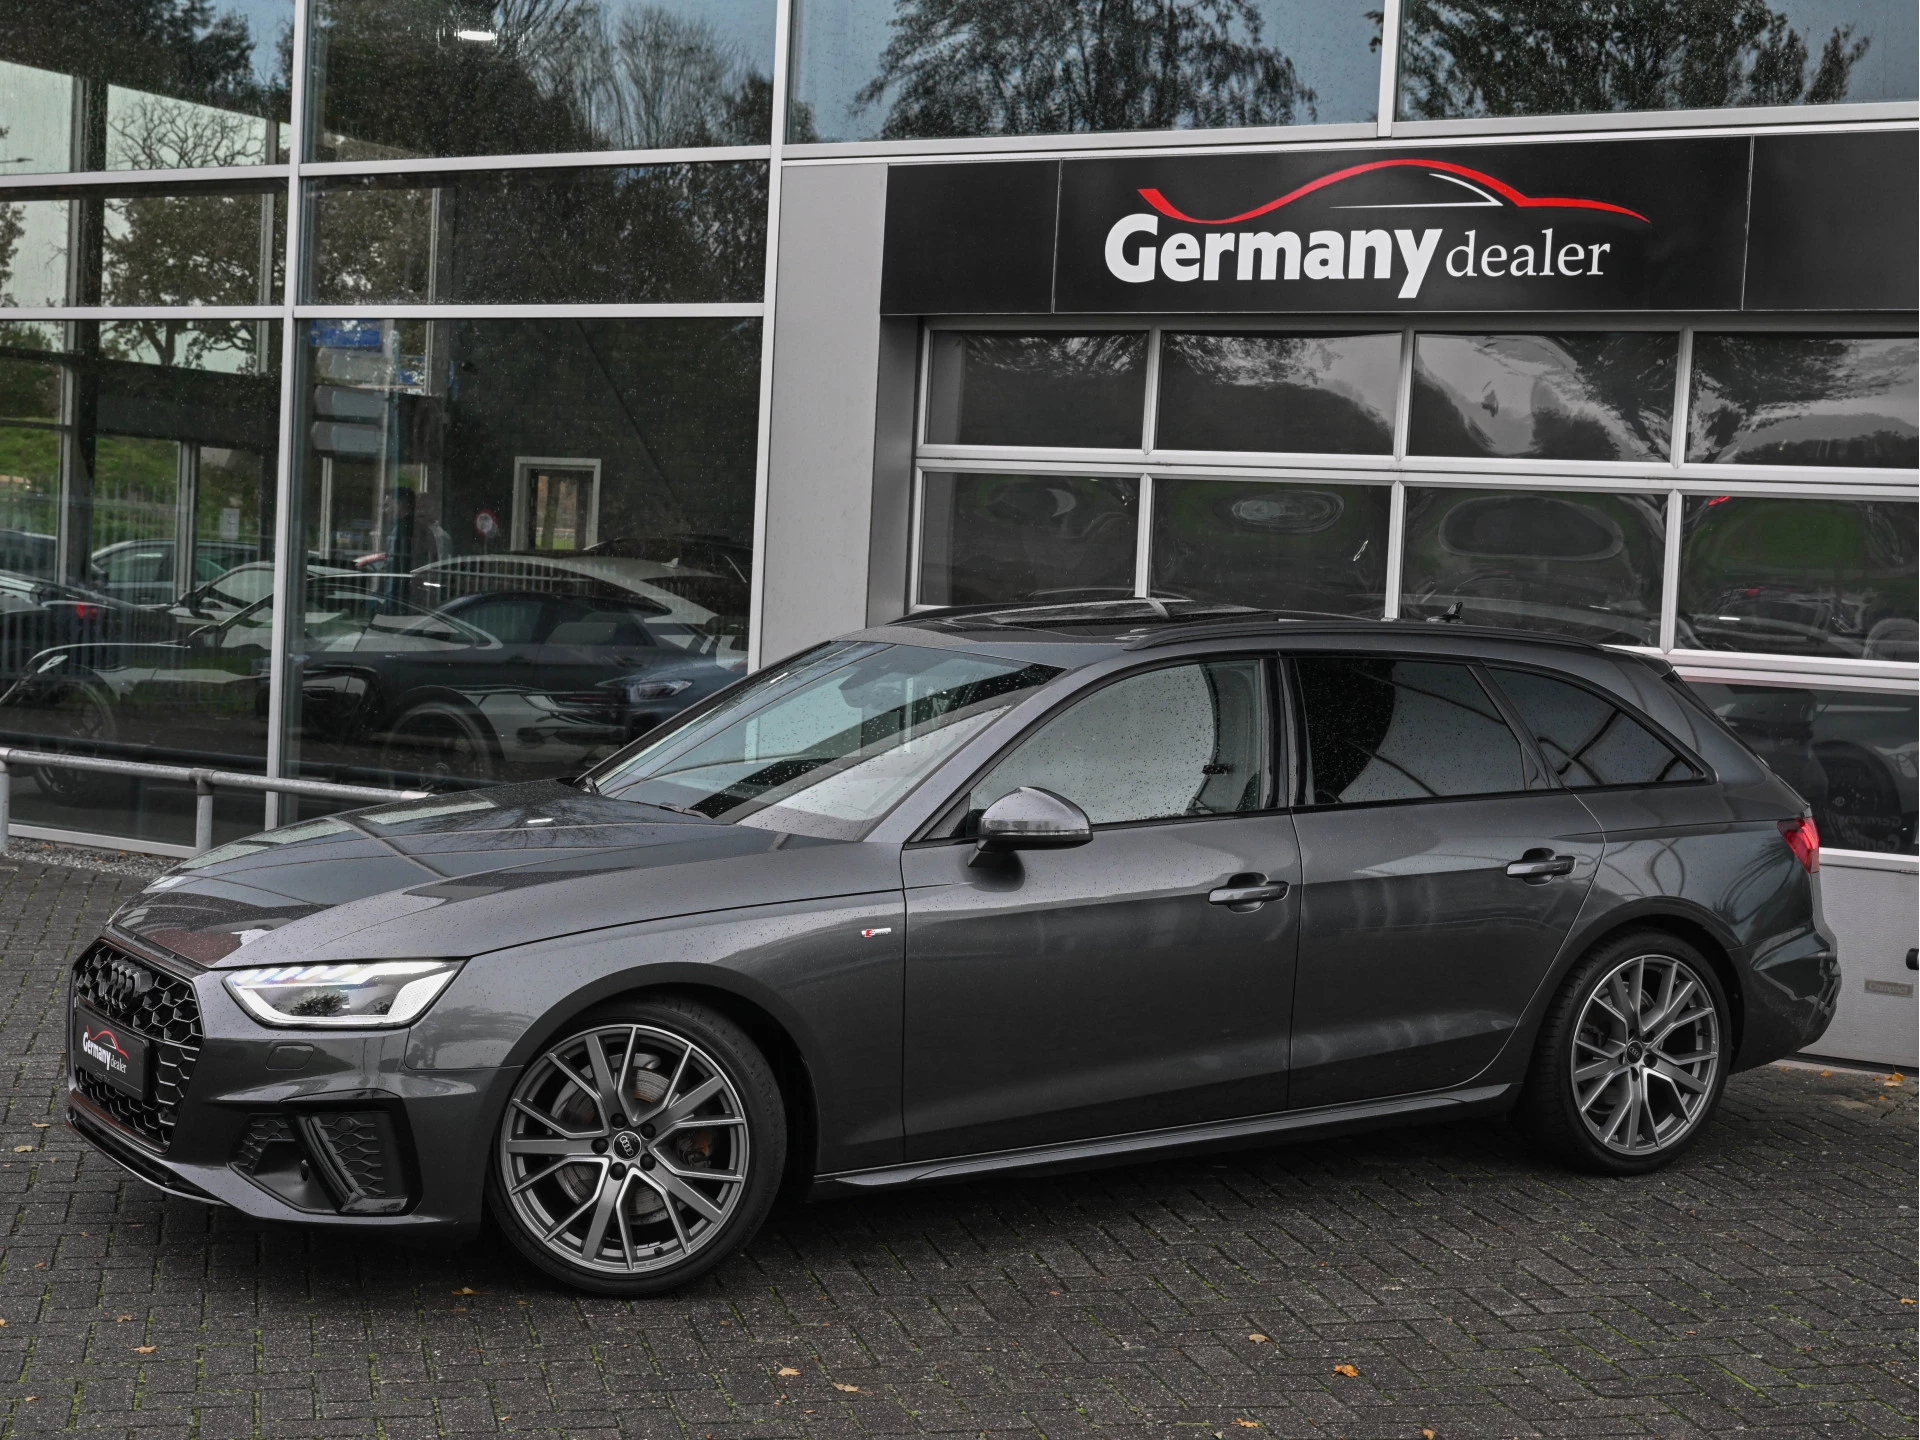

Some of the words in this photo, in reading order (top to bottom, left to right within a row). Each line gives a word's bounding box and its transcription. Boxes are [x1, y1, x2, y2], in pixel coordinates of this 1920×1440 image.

[1105, 213, 1442, 299] Germany
[1445, 229, 1611, 277] dealer
[83, 1032, 111, 1070] Germany
[111, 1055, 127, 1073] dealer
